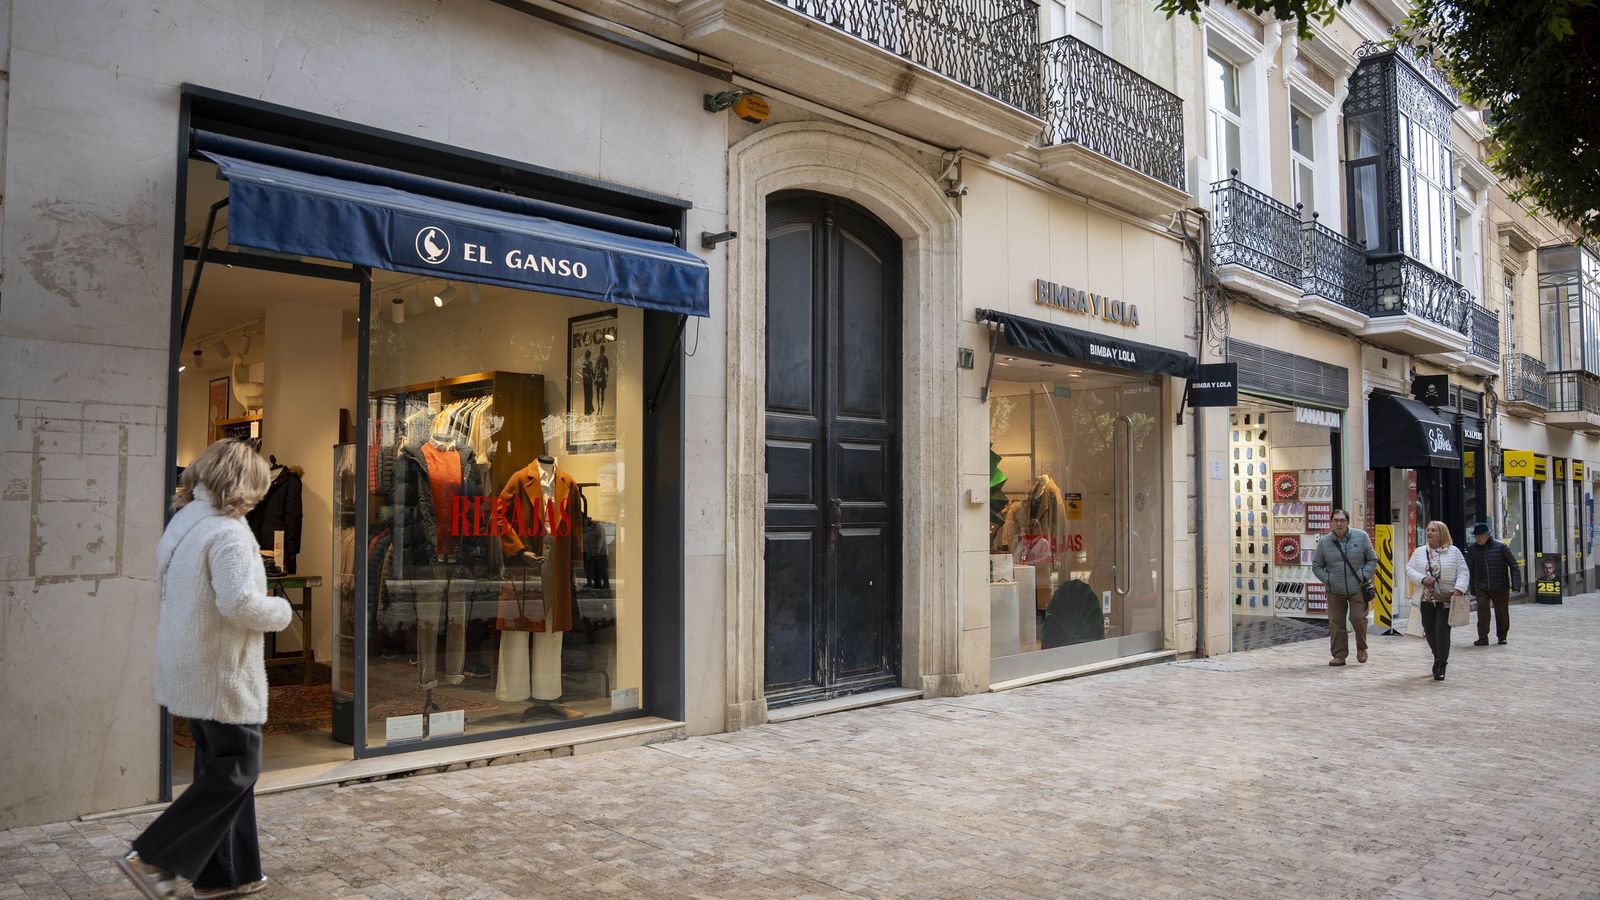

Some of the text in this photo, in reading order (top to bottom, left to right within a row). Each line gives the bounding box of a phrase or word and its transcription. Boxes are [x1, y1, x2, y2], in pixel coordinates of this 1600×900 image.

[463, 243, 588, 279] EL GANSO
[1035, 278, 1140, 328] BIMBA Y LOLA
[1089, 343, 1136, 363] BIMBA Y LOLA
[449, 495, 572, 537] REBAJAS
[1308, 513, 1330, 521] REBAJAS
